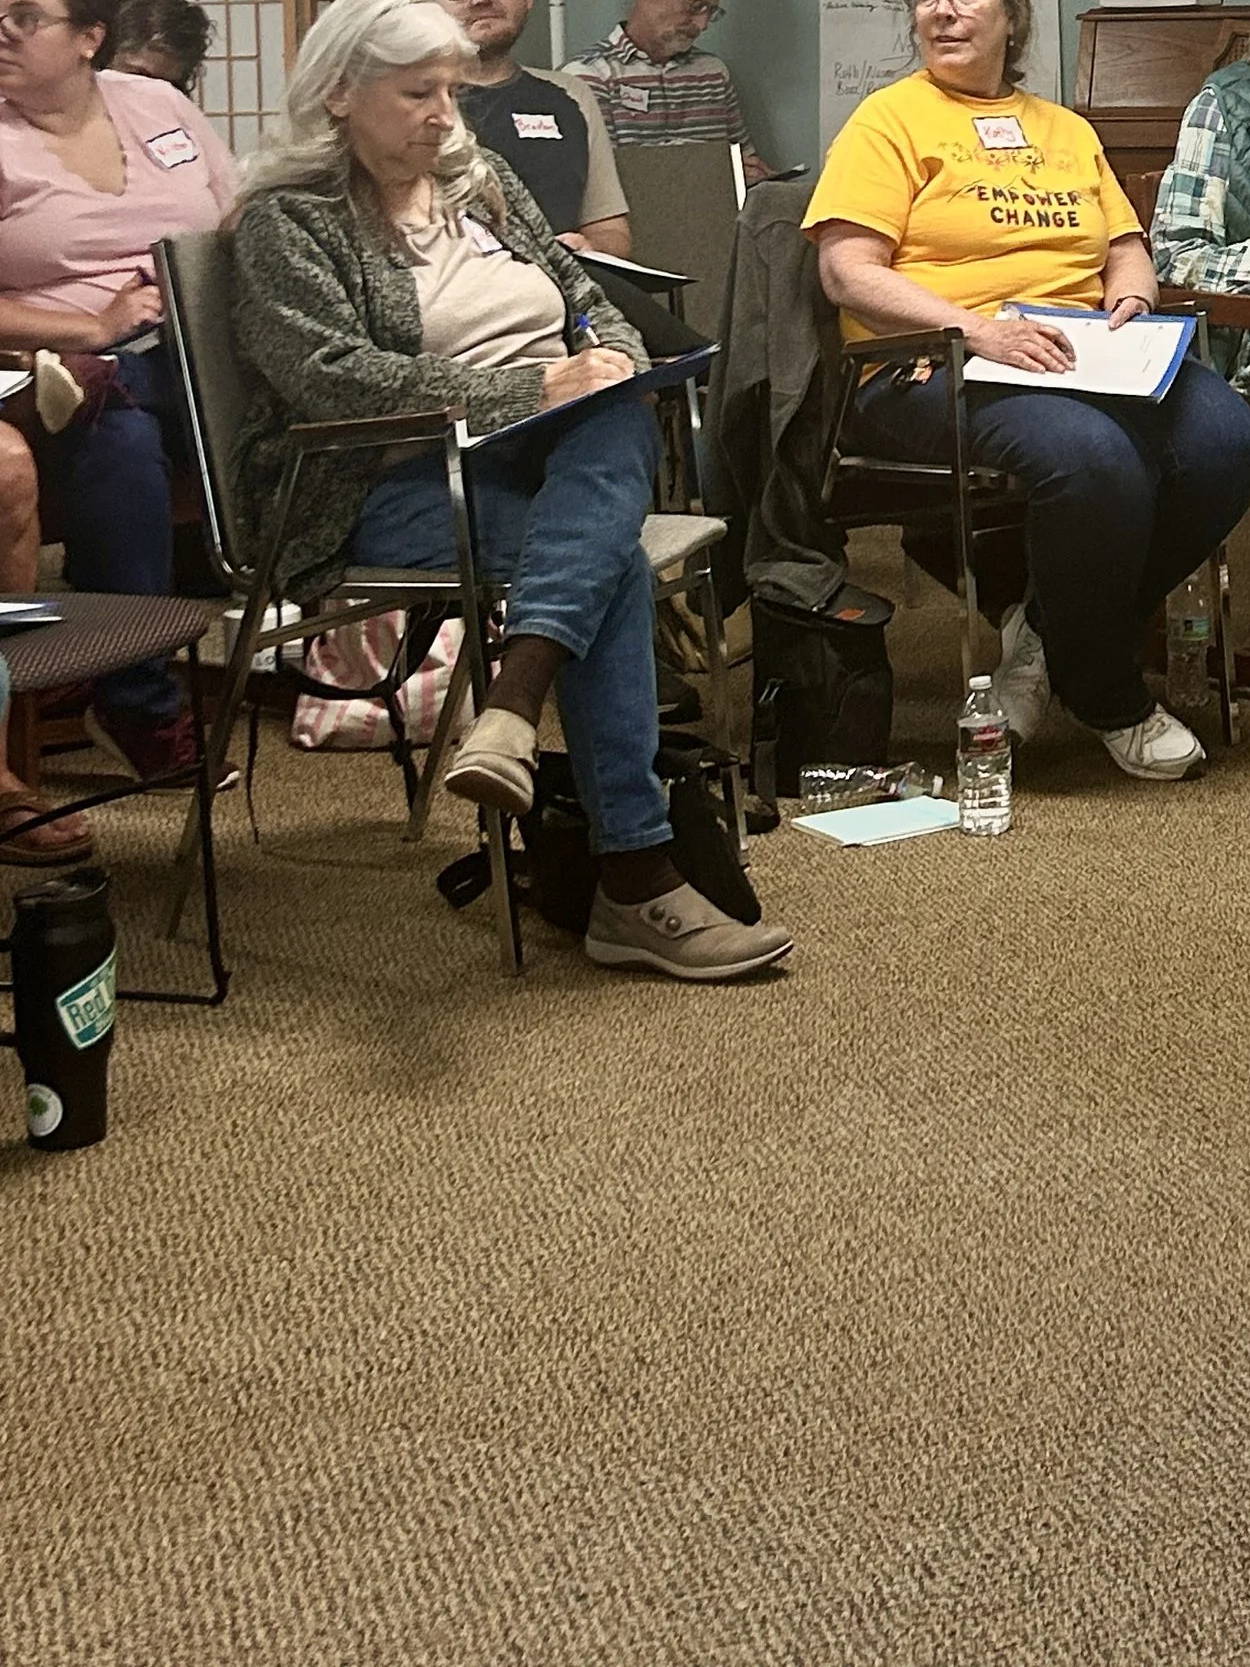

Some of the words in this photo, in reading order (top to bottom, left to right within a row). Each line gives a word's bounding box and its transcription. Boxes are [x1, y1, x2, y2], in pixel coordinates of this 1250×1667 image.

[977, 185, 1081, 206] EMPOWER
[990, 206, 1081, 228] CHANGE
[66, 987, 106, 1031] Red
